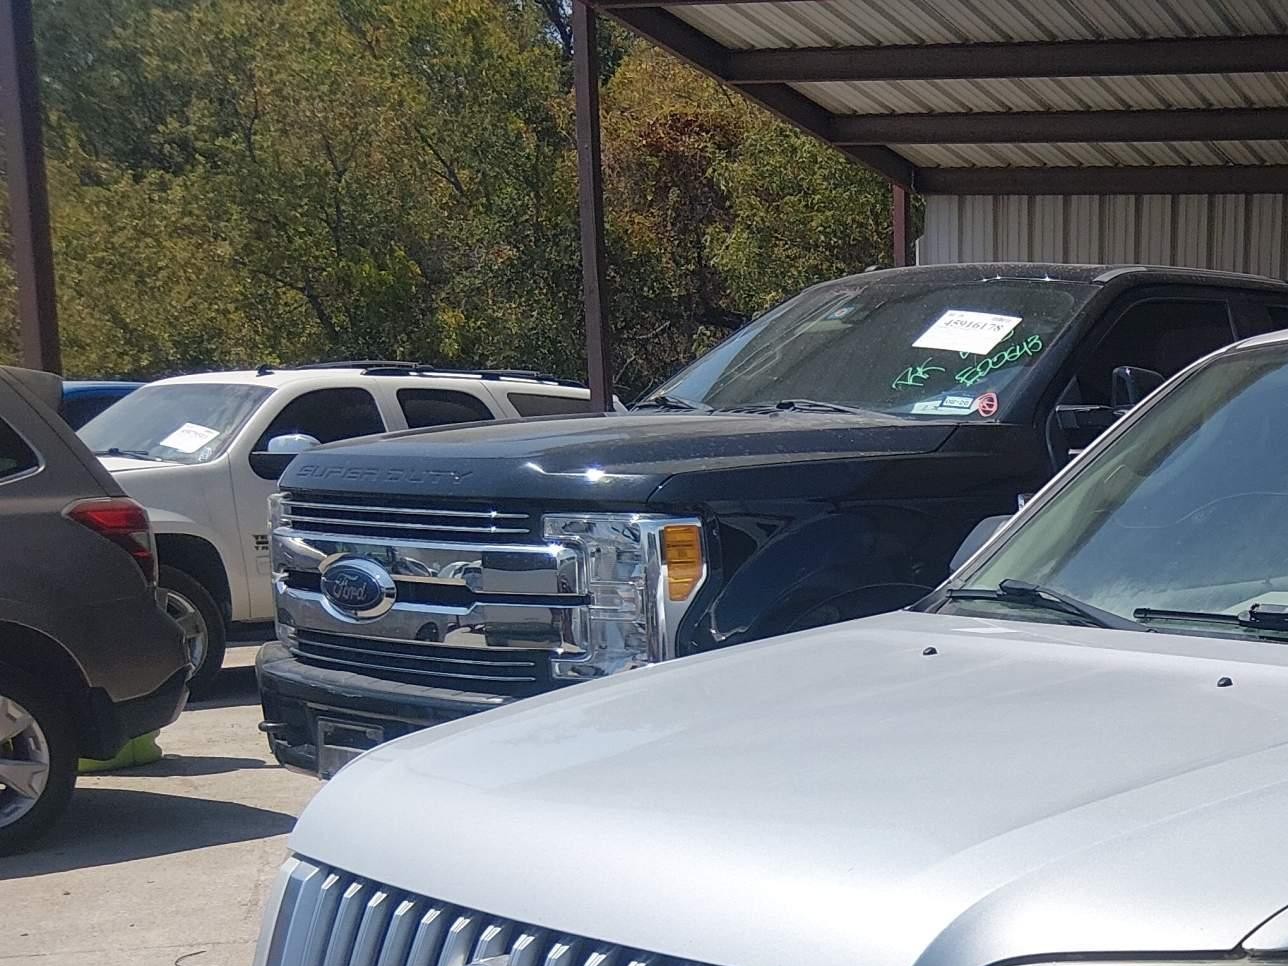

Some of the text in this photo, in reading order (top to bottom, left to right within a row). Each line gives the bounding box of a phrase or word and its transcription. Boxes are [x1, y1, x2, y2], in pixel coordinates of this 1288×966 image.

[296, 464, 473, 485] SUPER DUTY
[333, 573, 368, 601] Ford
